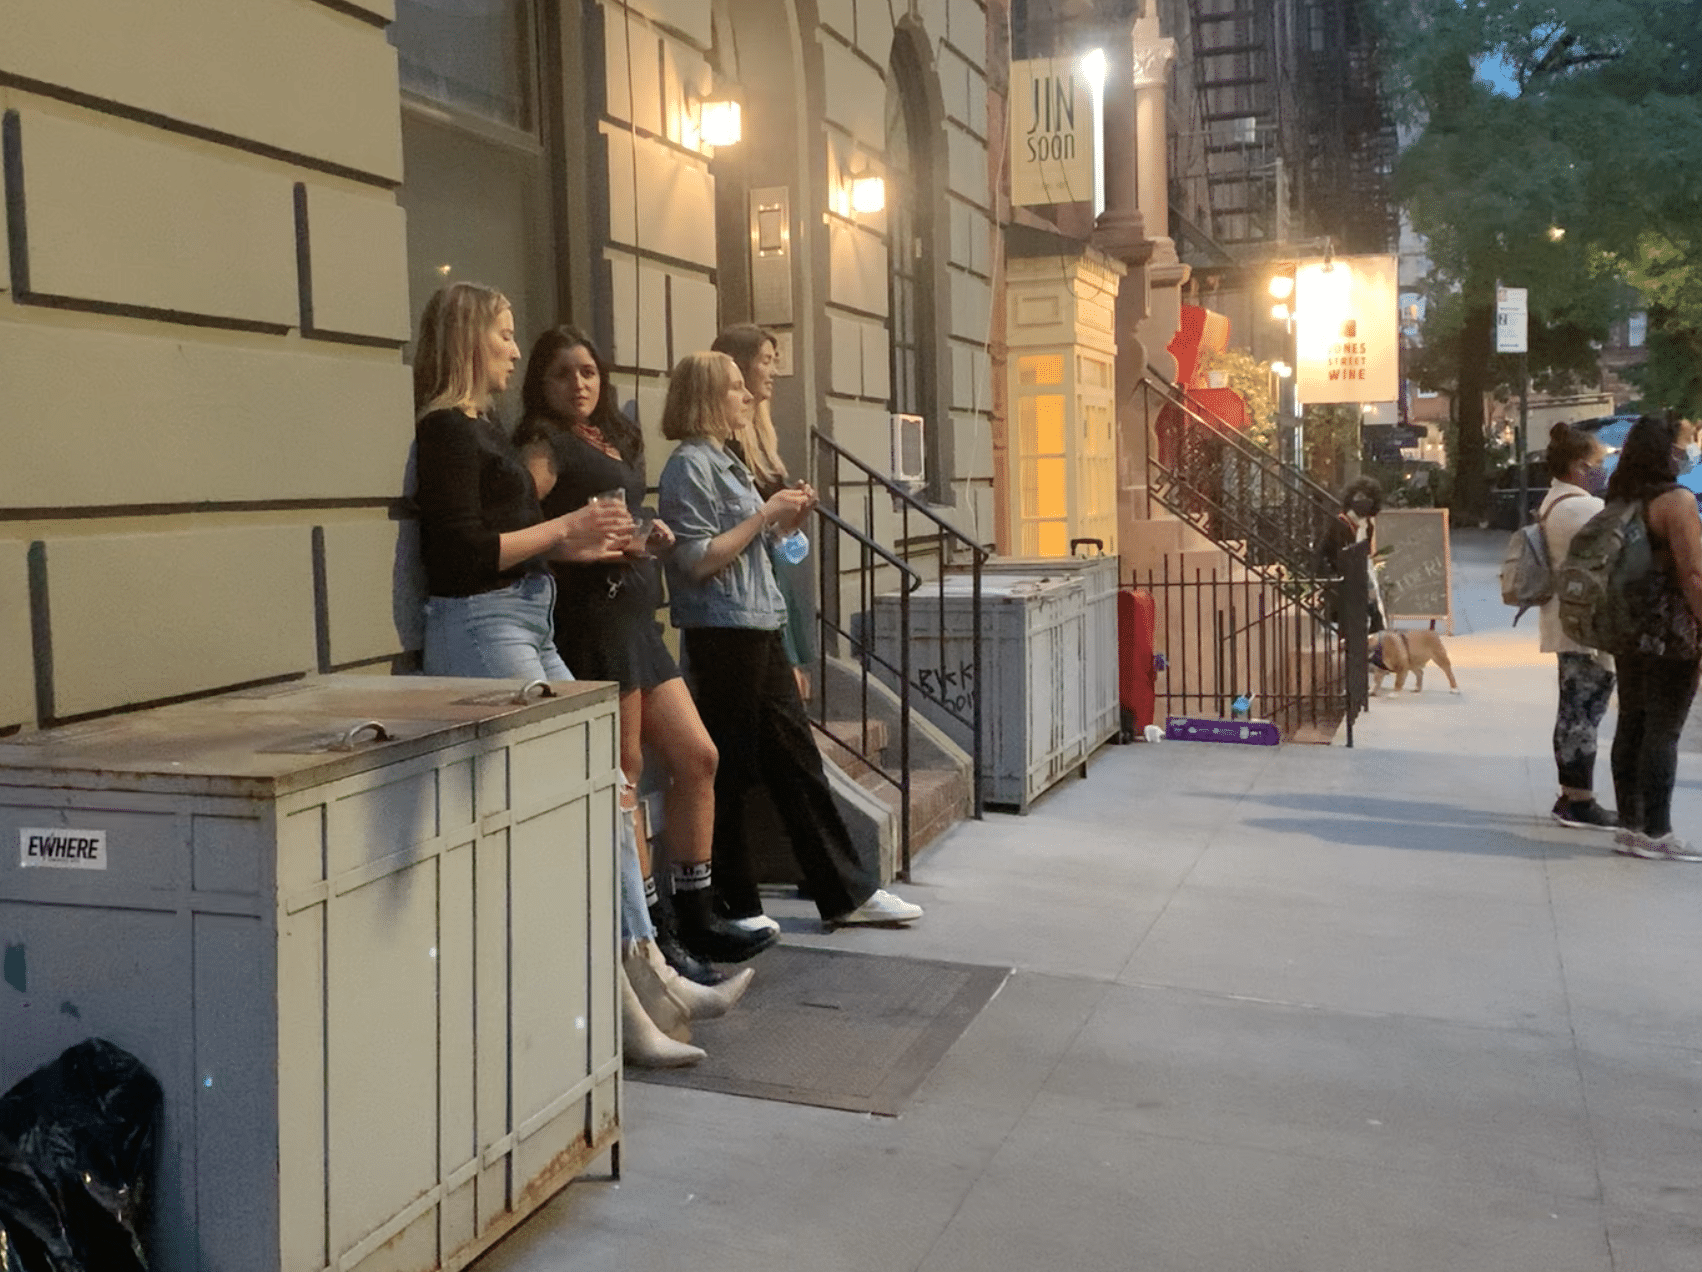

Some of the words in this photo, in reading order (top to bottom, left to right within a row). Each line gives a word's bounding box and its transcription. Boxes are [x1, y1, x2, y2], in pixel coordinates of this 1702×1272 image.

[1027, 75, 1075, 135] JIN
[1328, 368, 1367, 381] WINE
[27, 835, 100, 860] EWHERE
